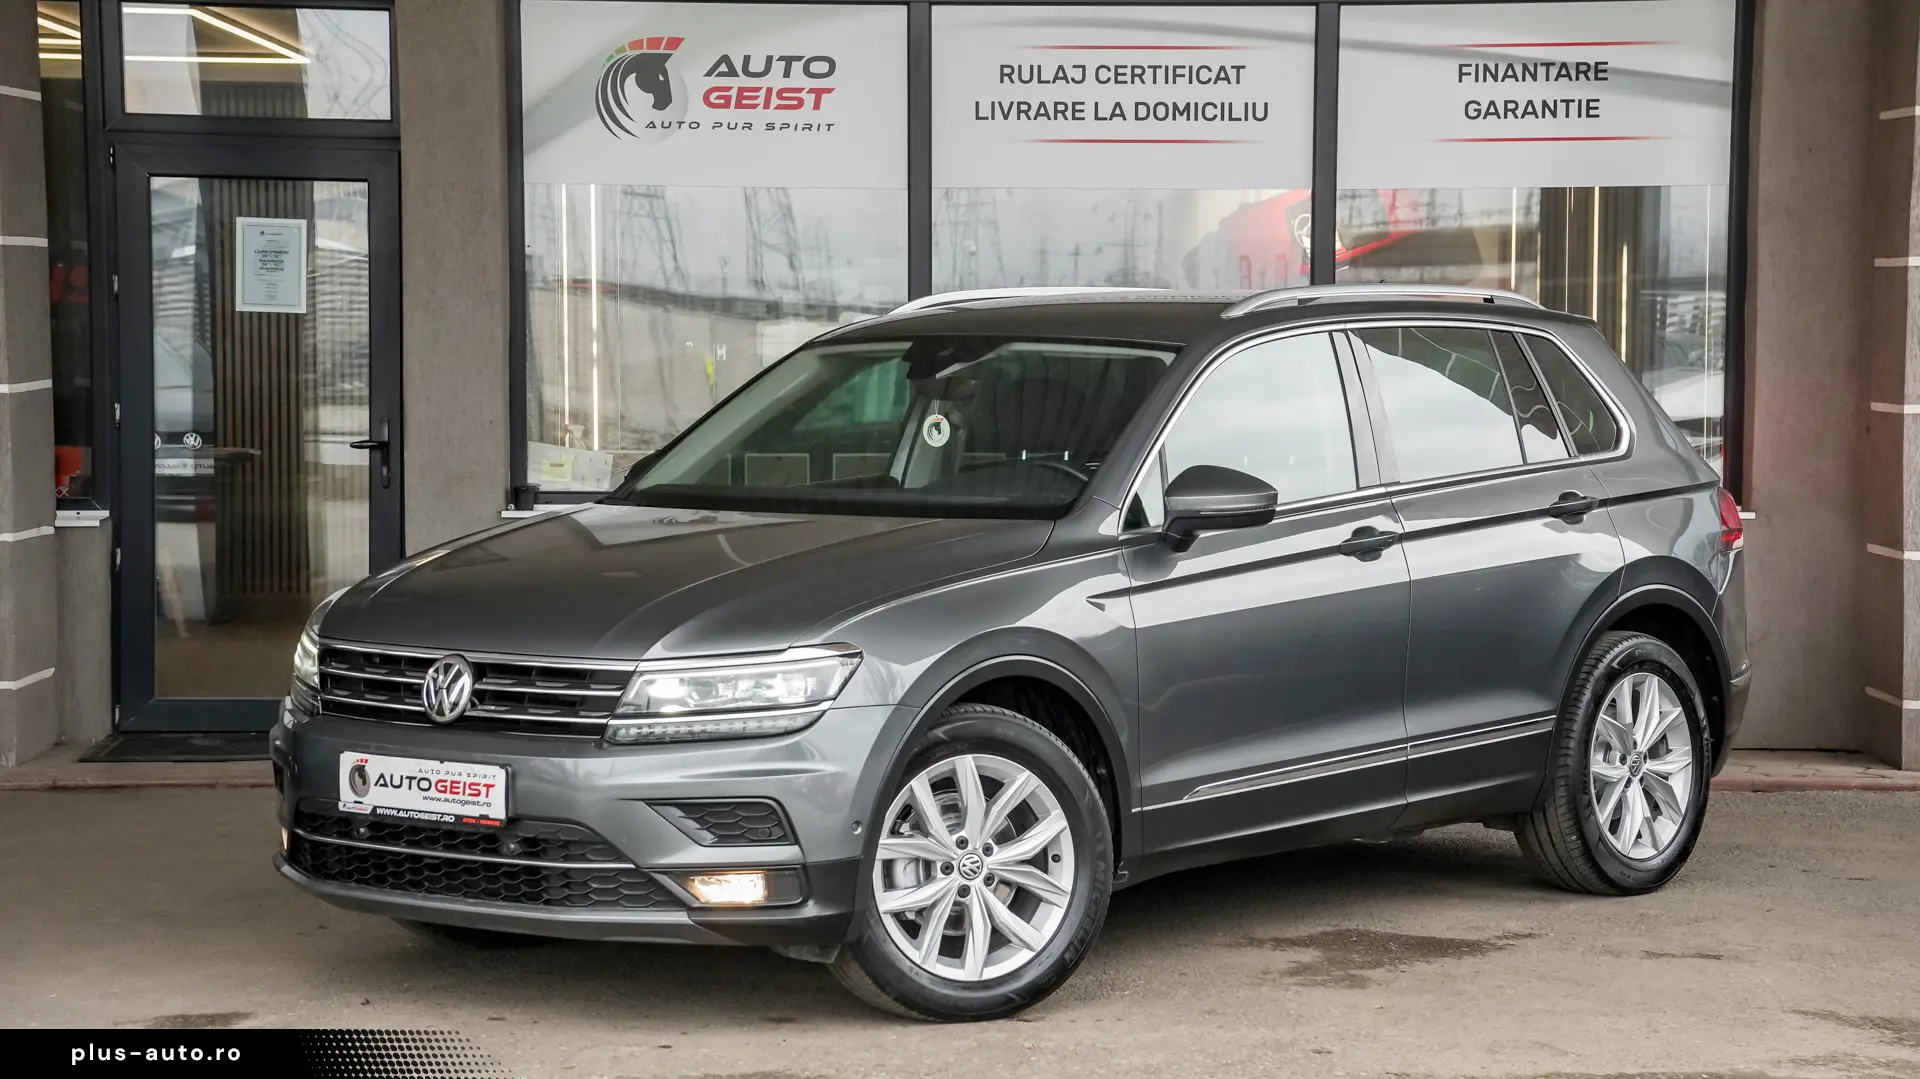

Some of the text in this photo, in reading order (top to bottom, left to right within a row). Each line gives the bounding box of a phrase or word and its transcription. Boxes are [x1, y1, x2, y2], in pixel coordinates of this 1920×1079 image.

[703, 54, 836, 79] AUTO
[999, 64, 1246, 85] RULAJ CERTIFICAT
[1457, 61, 1610, 83] FINANTARE
[703, 86, 835, 110] GEIST
[975, 101, 1269, 122] LIVRARE LA DOMICILIU
[1464, 98, 1601, 120] GARANTIE
[645, 121, 835, 132] AUTO PUR SPIRIT
[422, 795, 492, 808] www.autogeist.ro
[376, 807, 455, 823] WWW.AUTOGEIST.RO
